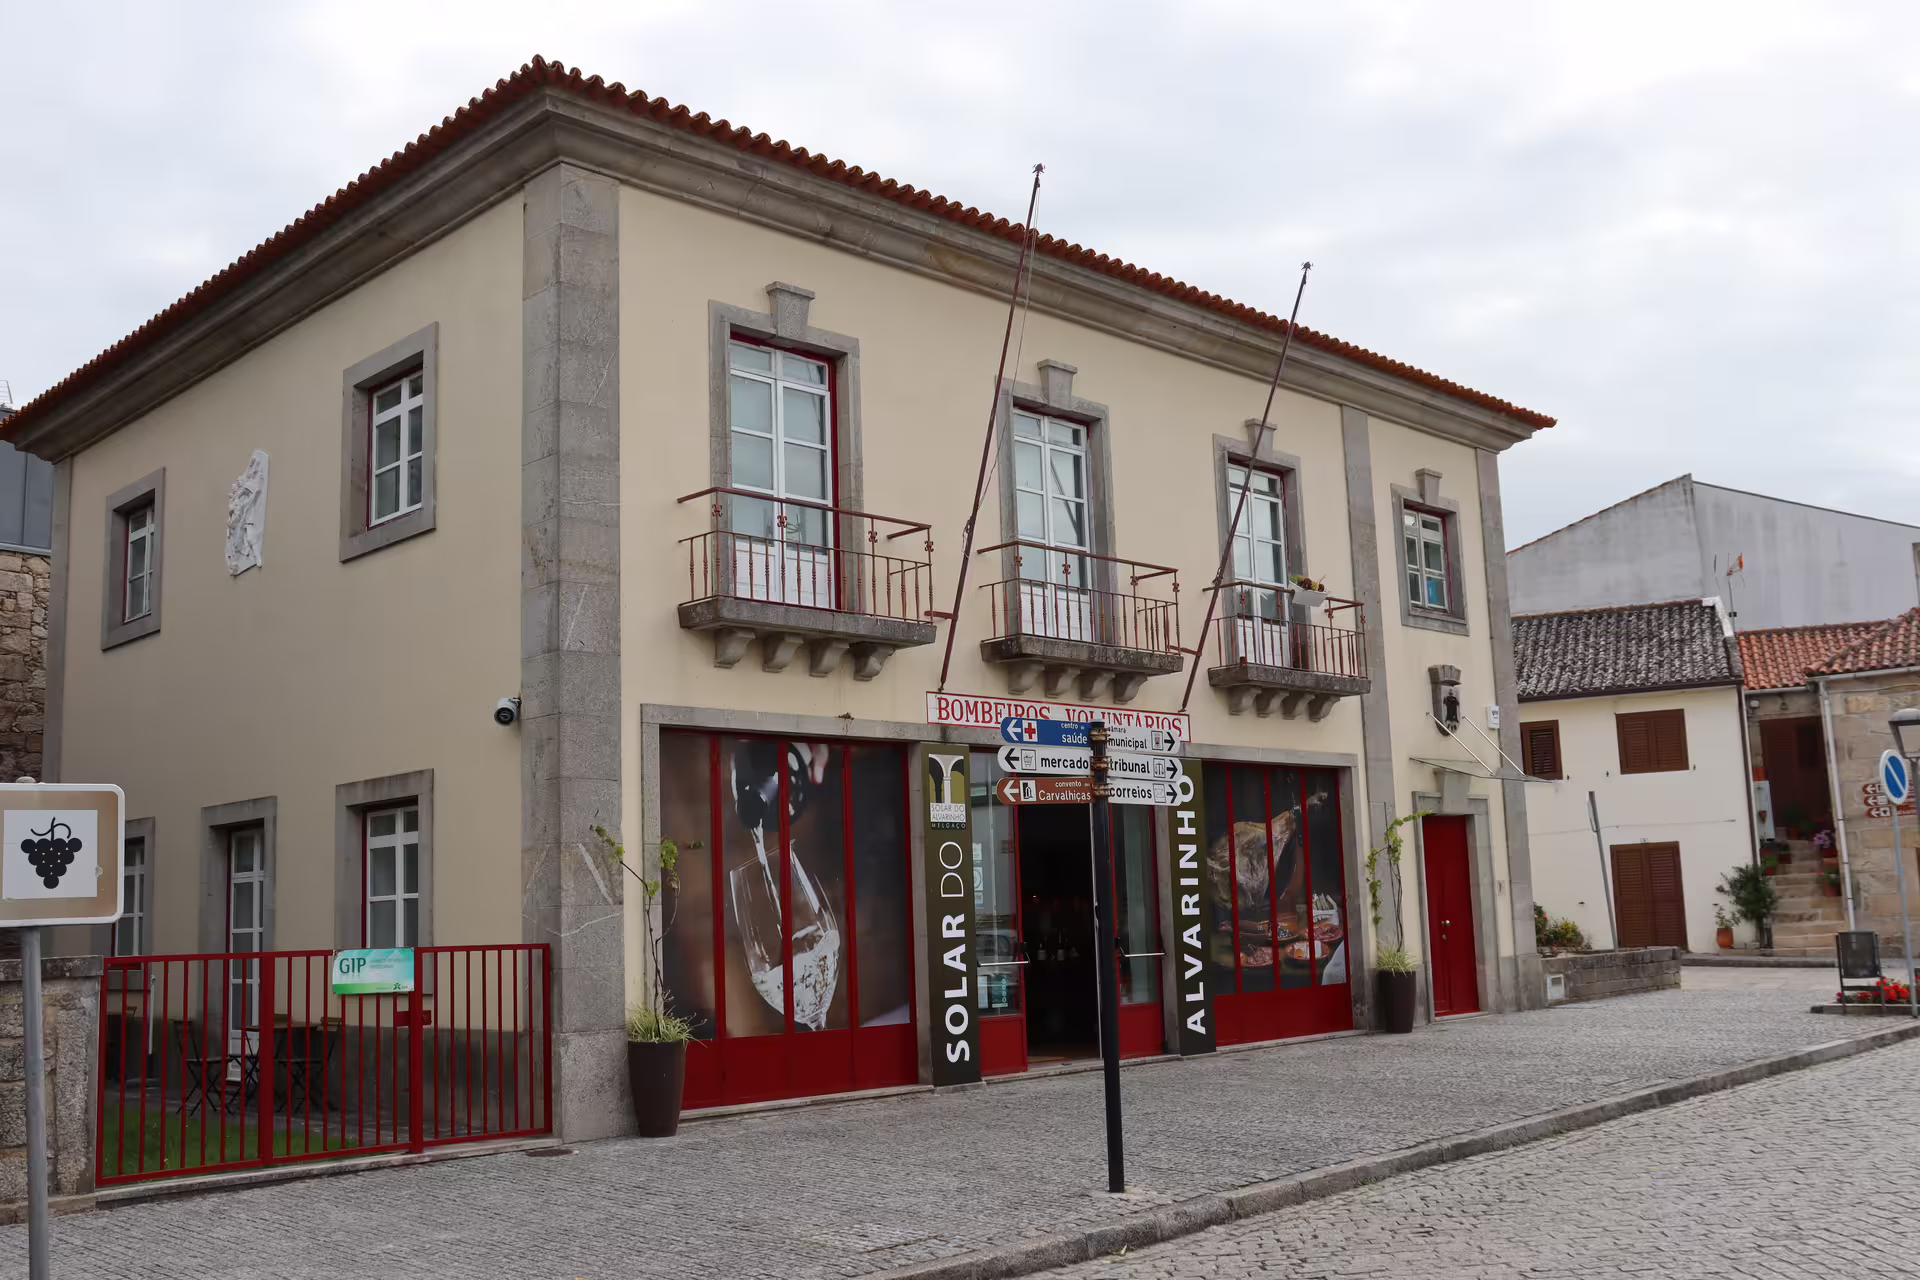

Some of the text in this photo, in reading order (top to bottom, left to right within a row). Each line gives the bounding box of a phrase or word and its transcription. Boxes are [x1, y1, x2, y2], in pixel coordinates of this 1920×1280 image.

[938, 697, 1051, 724] BOMBEIROS
[1060, 722, 1079, 730] centro
[1061, 732, 1088, 744] saúde
[1108, 737, 1147, 750] municipal
[1040, 757, 1089, 769] mercado
[1109, 758, 1150, 774] tribunal
[1055, 780, 1082, 788] convento
[1038, 790, 1091, 803] Carvalhiças
[1109, 786, 1152, 799] correios
[931, 804, 965, 813] SOLAR DO
[931, 813, 966, 822] ALVARINHO
[1176, 775, 1206, 1035] ALVARINHO
[939, 841, 970, 1063] SOLAR DO
[339, 957, 367, 974] GIP
